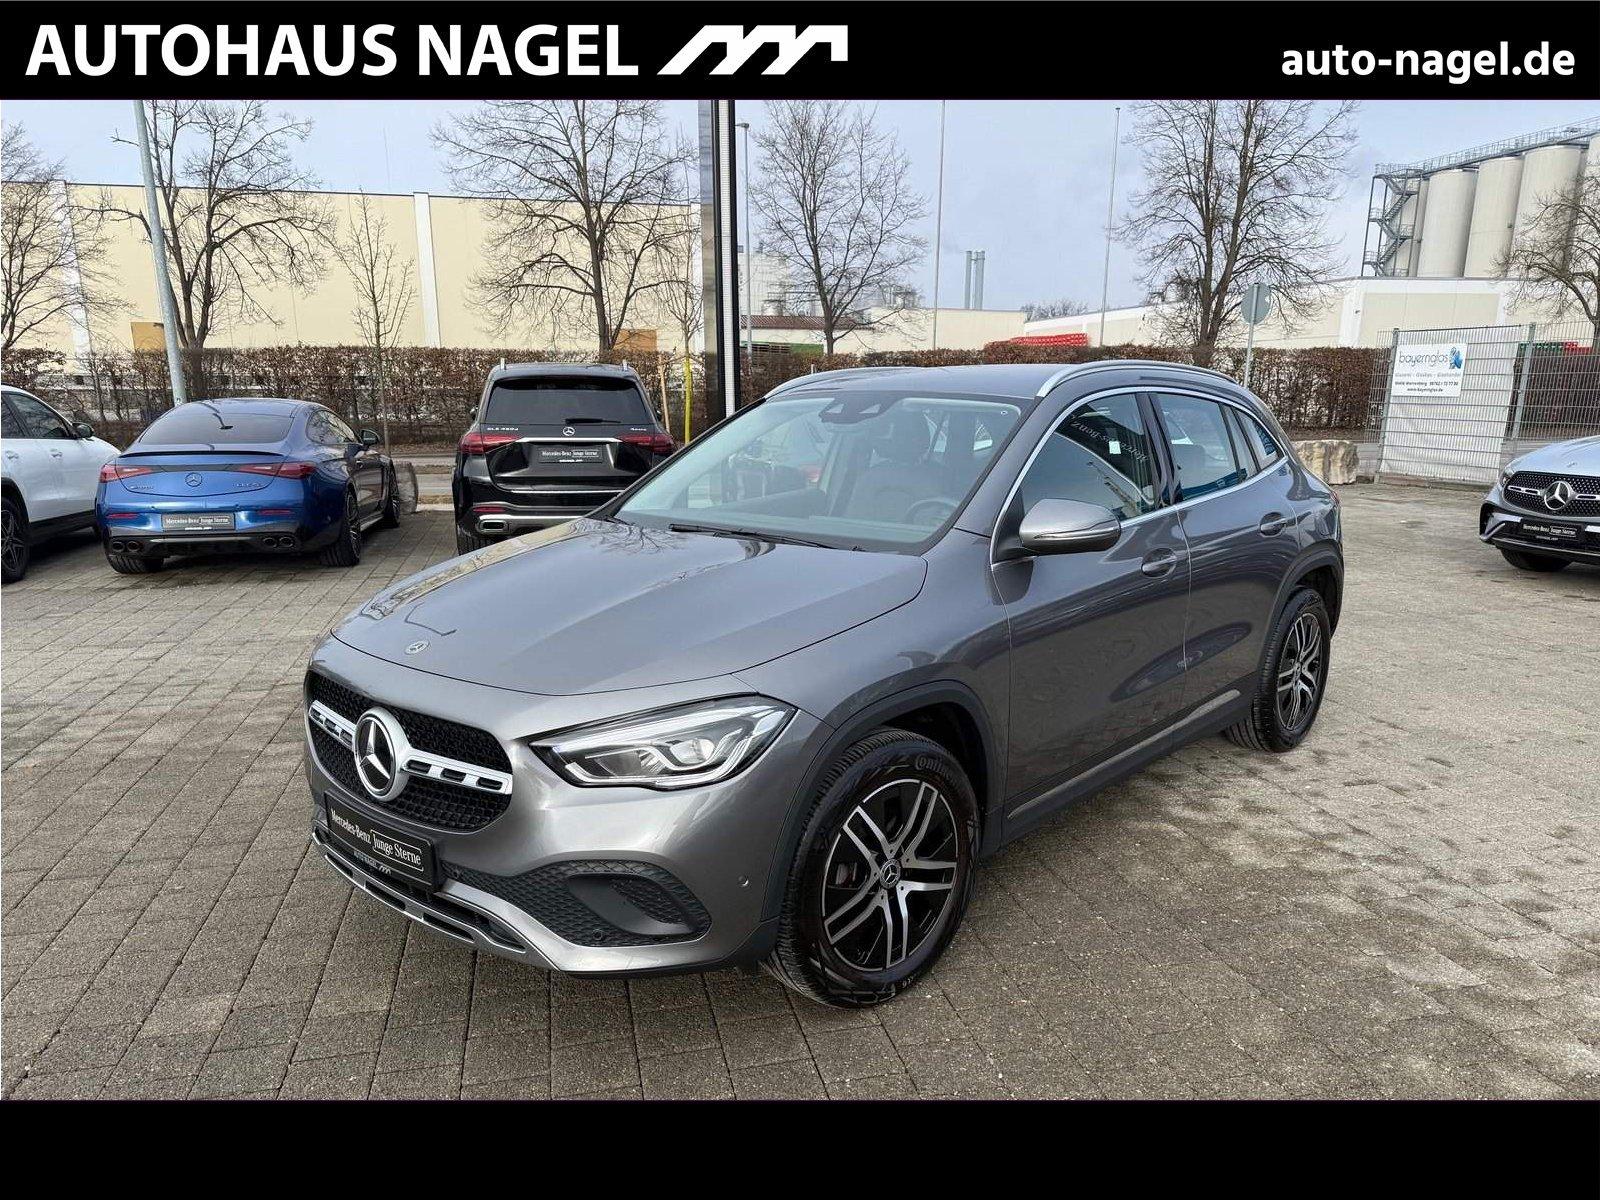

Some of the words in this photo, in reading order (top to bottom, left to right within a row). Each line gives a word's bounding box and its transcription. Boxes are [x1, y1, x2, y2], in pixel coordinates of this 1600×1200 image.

[330, 807, 371, 845] Mercedes-Benz
[373, 833, 394, 856] Junge
[394, 843, 422, 865] Sterne
